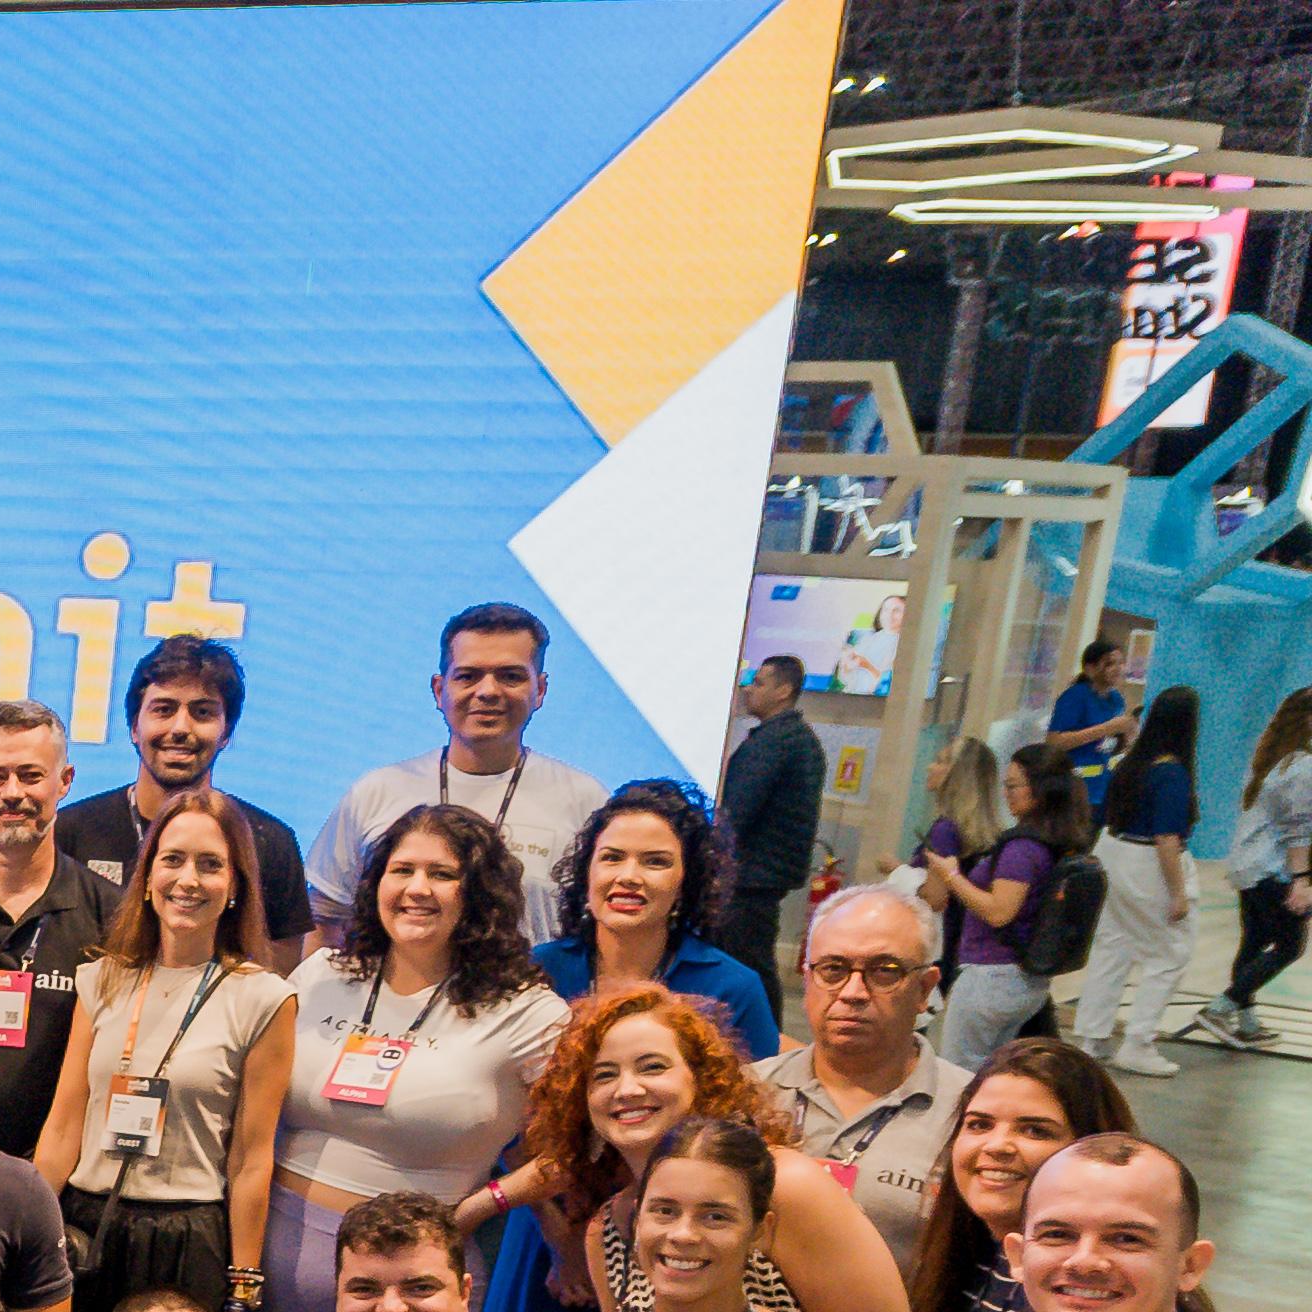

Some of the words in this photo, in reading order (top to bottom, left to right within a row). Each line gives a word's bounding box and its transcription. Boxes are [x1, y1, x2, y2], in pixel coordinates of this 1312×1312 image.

[35, 969, 74, 992] ain
[339, 1087, 367, 1099] ALPHA
[117, 1138, 140, 1148] GUEST
